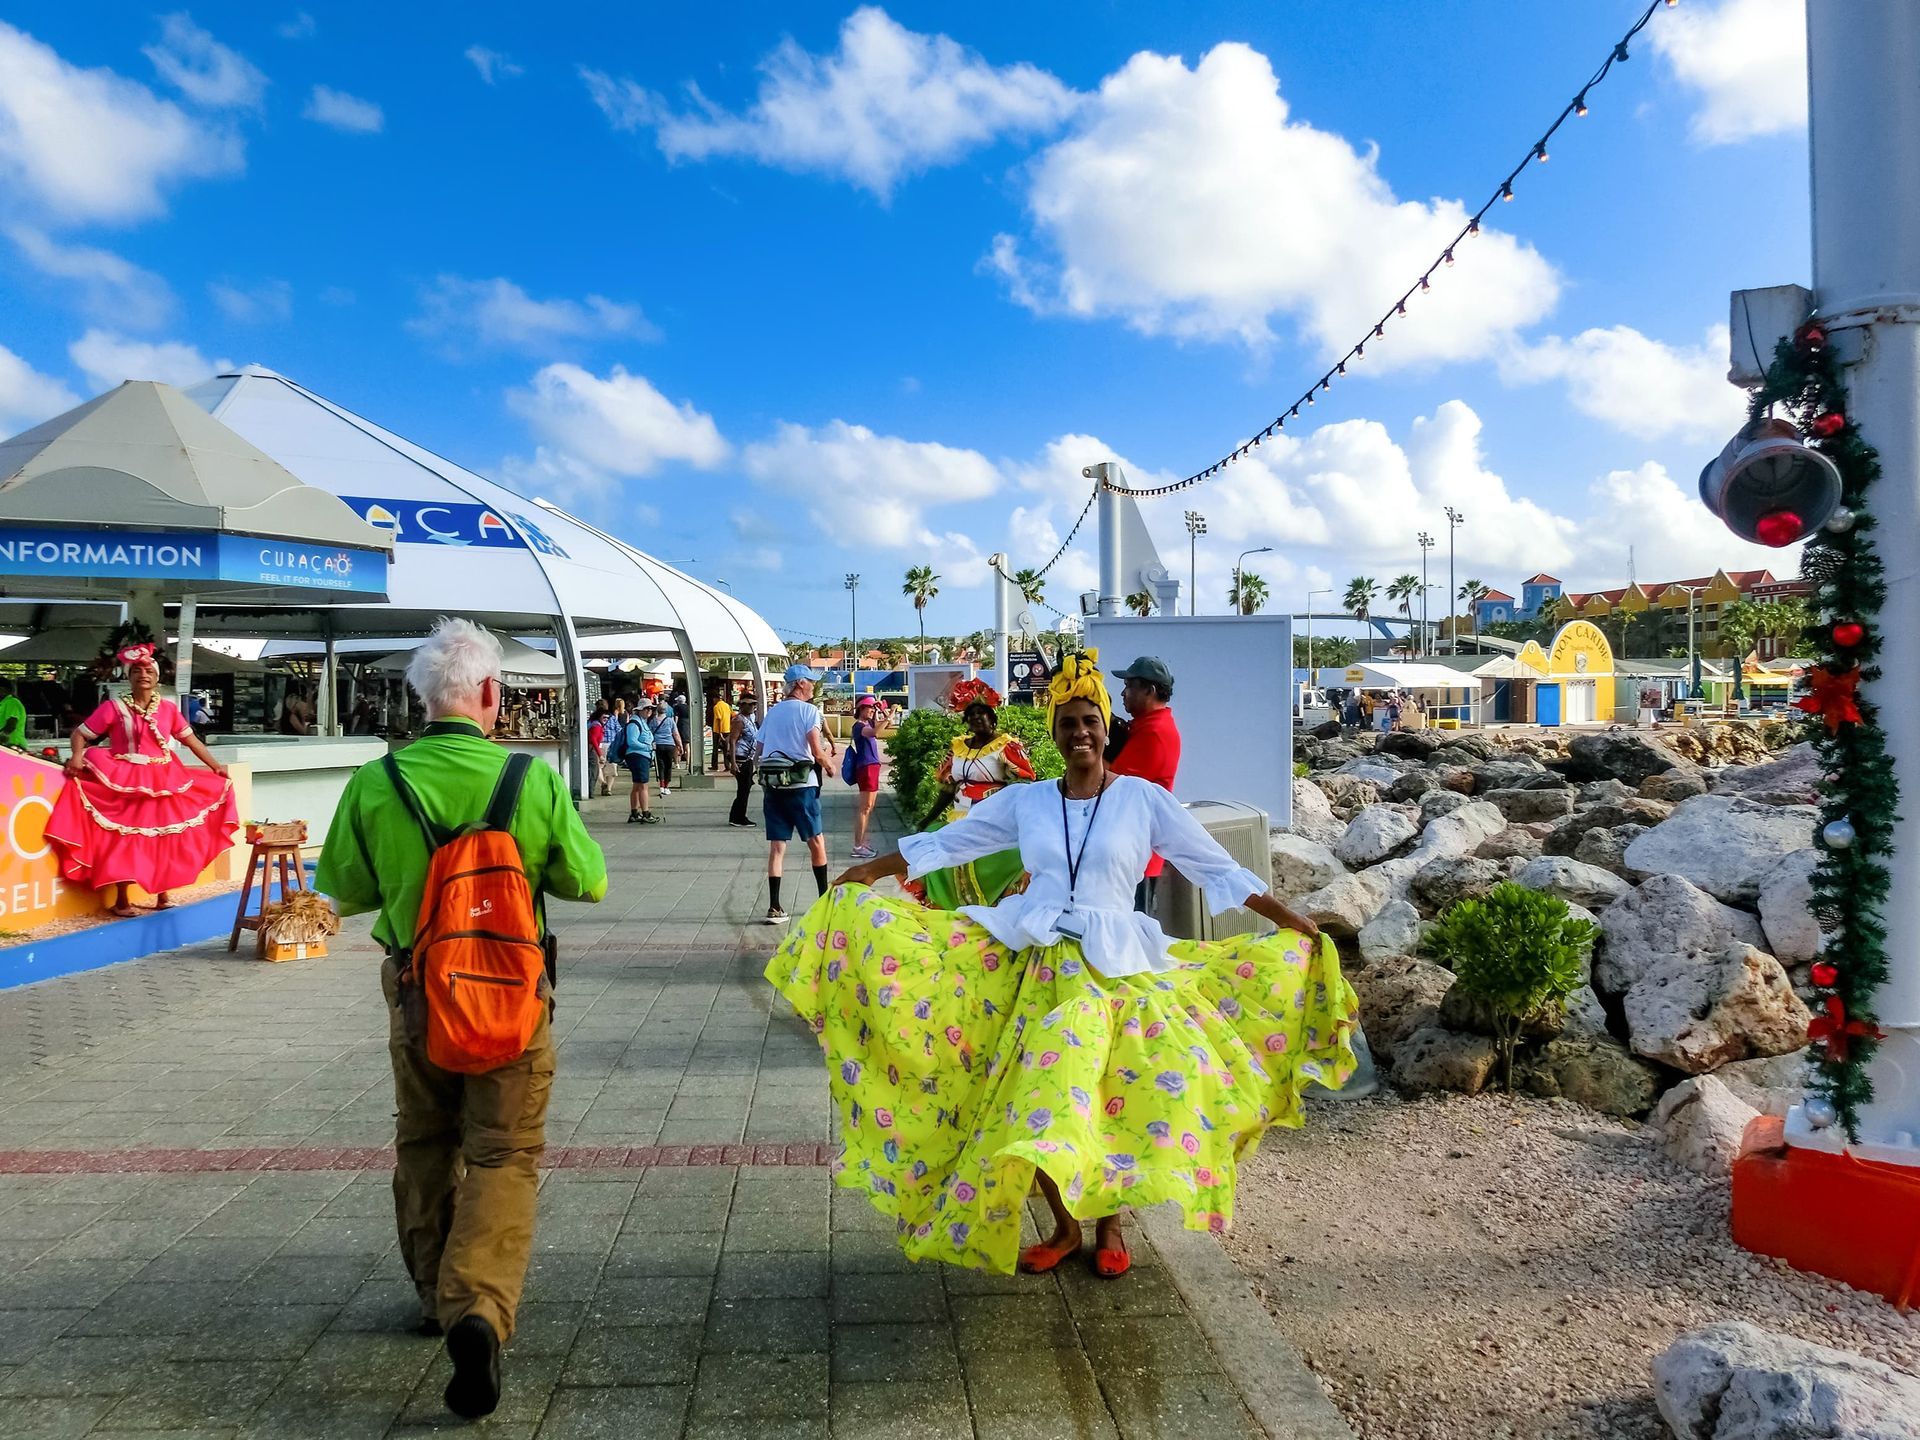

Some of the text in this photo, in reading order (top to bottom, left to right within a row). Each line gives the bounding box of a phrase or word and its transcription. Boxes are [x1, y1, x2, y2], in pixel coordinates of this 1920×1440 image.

[260, 573, 352, 588] FEEL IT FOR YOURSELF
[1554, 625, 1609, 662] DON CARIBE
